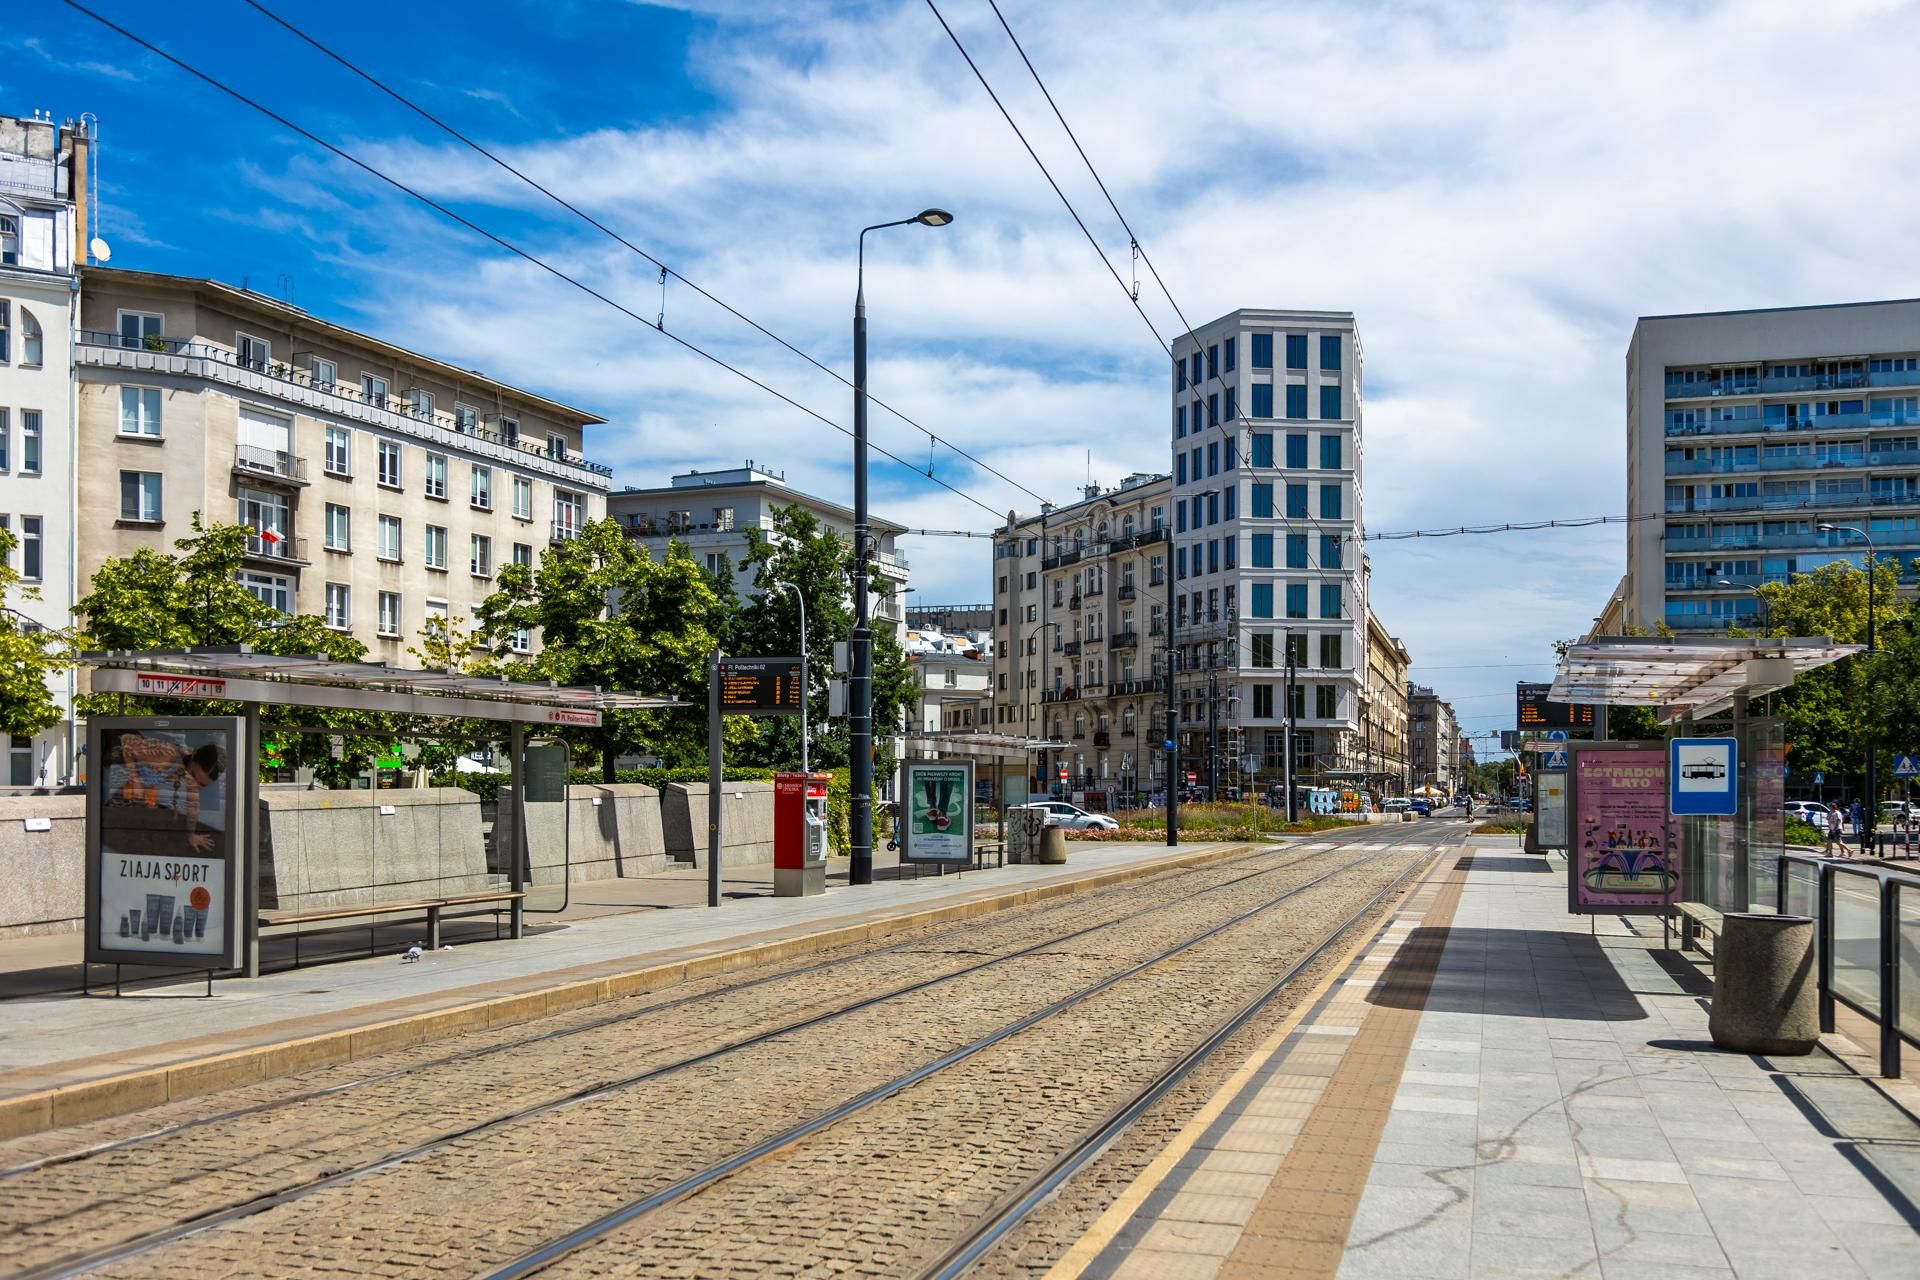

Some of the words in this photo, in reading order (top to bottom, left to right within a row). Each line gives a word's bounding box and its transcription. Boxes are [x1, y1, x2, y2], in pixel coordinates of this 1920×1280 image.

[142, 680, 150, 688] 10
[157, 681, 164, 689] 11
[1612, 778, 1650, 787] LATO
[120, 860, 160, 879] ZIAJA
[165, 863, 208, 882] SPORT
